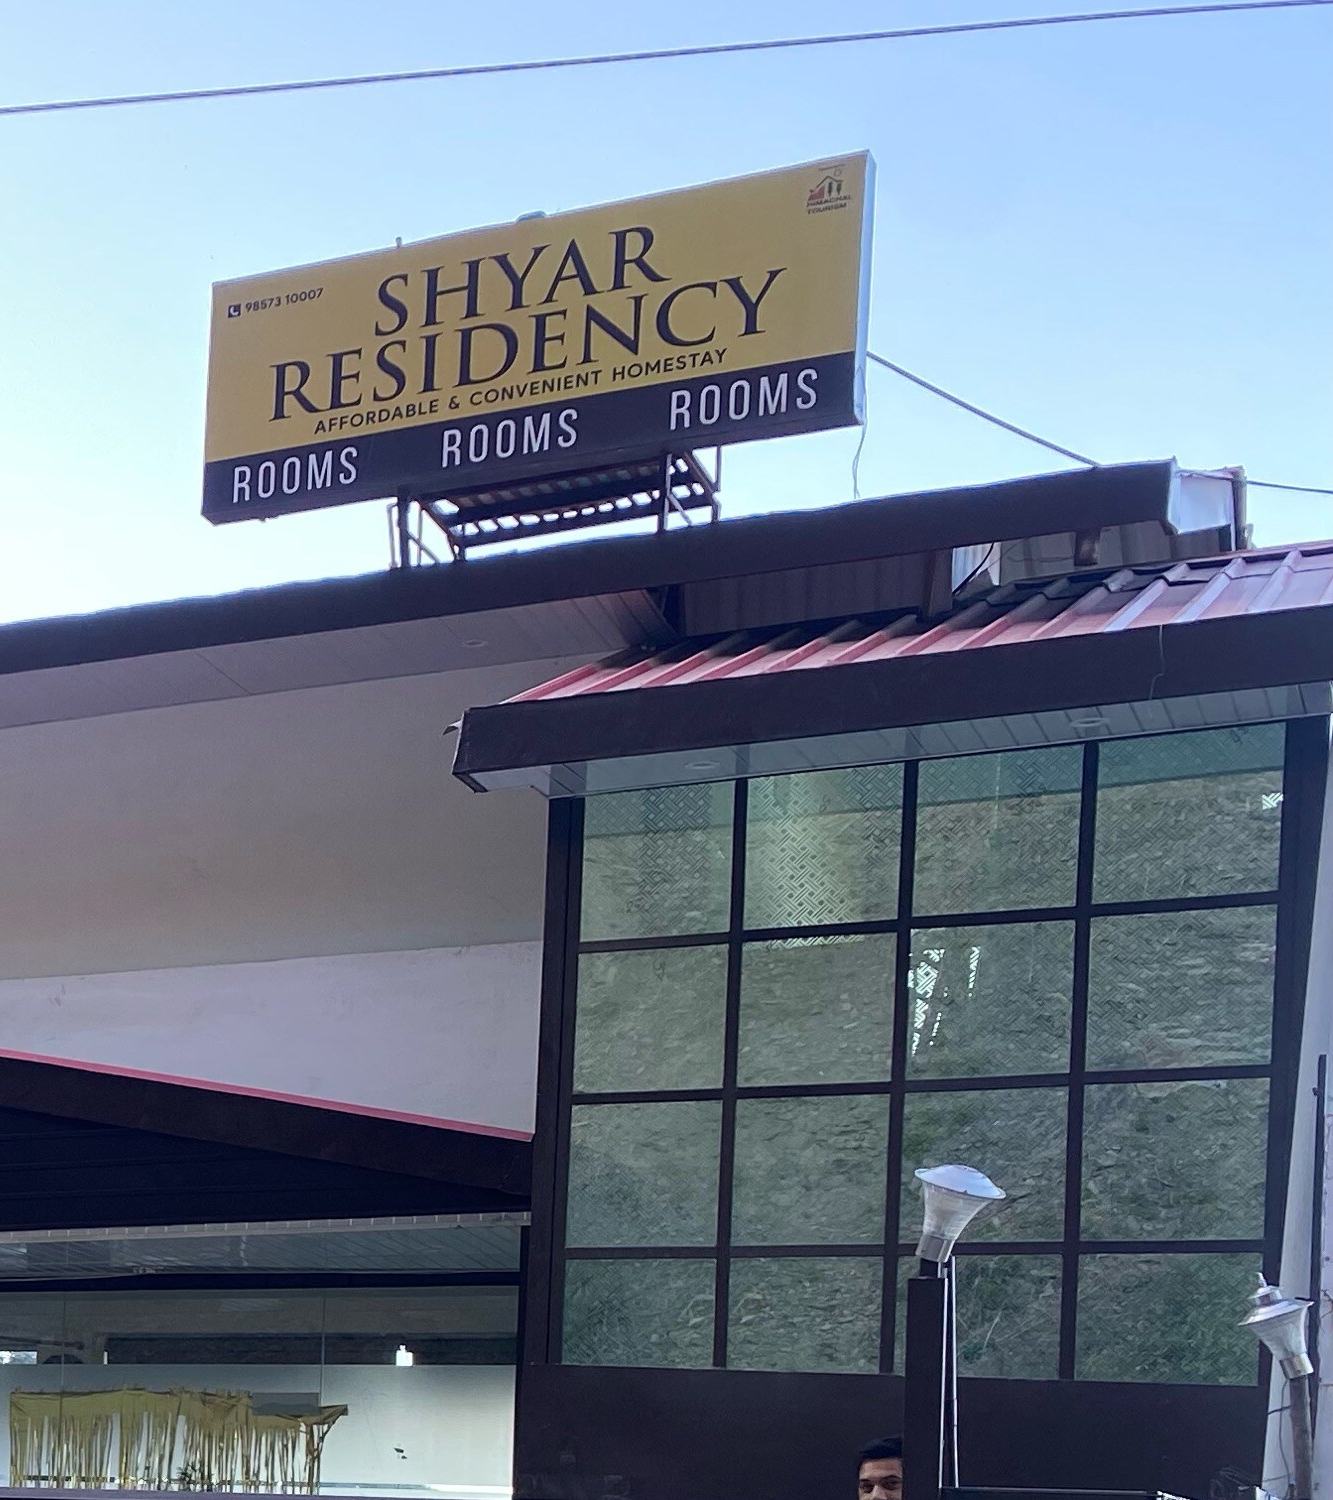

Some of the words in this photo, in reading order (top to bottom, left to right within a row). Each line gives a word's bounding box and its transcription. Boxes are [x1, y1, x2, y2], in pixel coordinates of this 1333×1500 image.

[245, 296, 282, 313] 98573
[284, 287, 324, 305] 10007
[374, 226, 672, 337] SHYAR
[268, 267, 788, 422] RESIDENCY
[314, 398, 440, 435] AFFORDABLE
[448, 396, 460, 410] &
[469, 370, 602, 406] CONVENIENT
[611, 347, 728, 382] HOMESTAY
[233, 446, 359, 503] ROOMS
[441, 408, 579, 469] ROOMS
[670, 368, 818, 431] ROOMS
